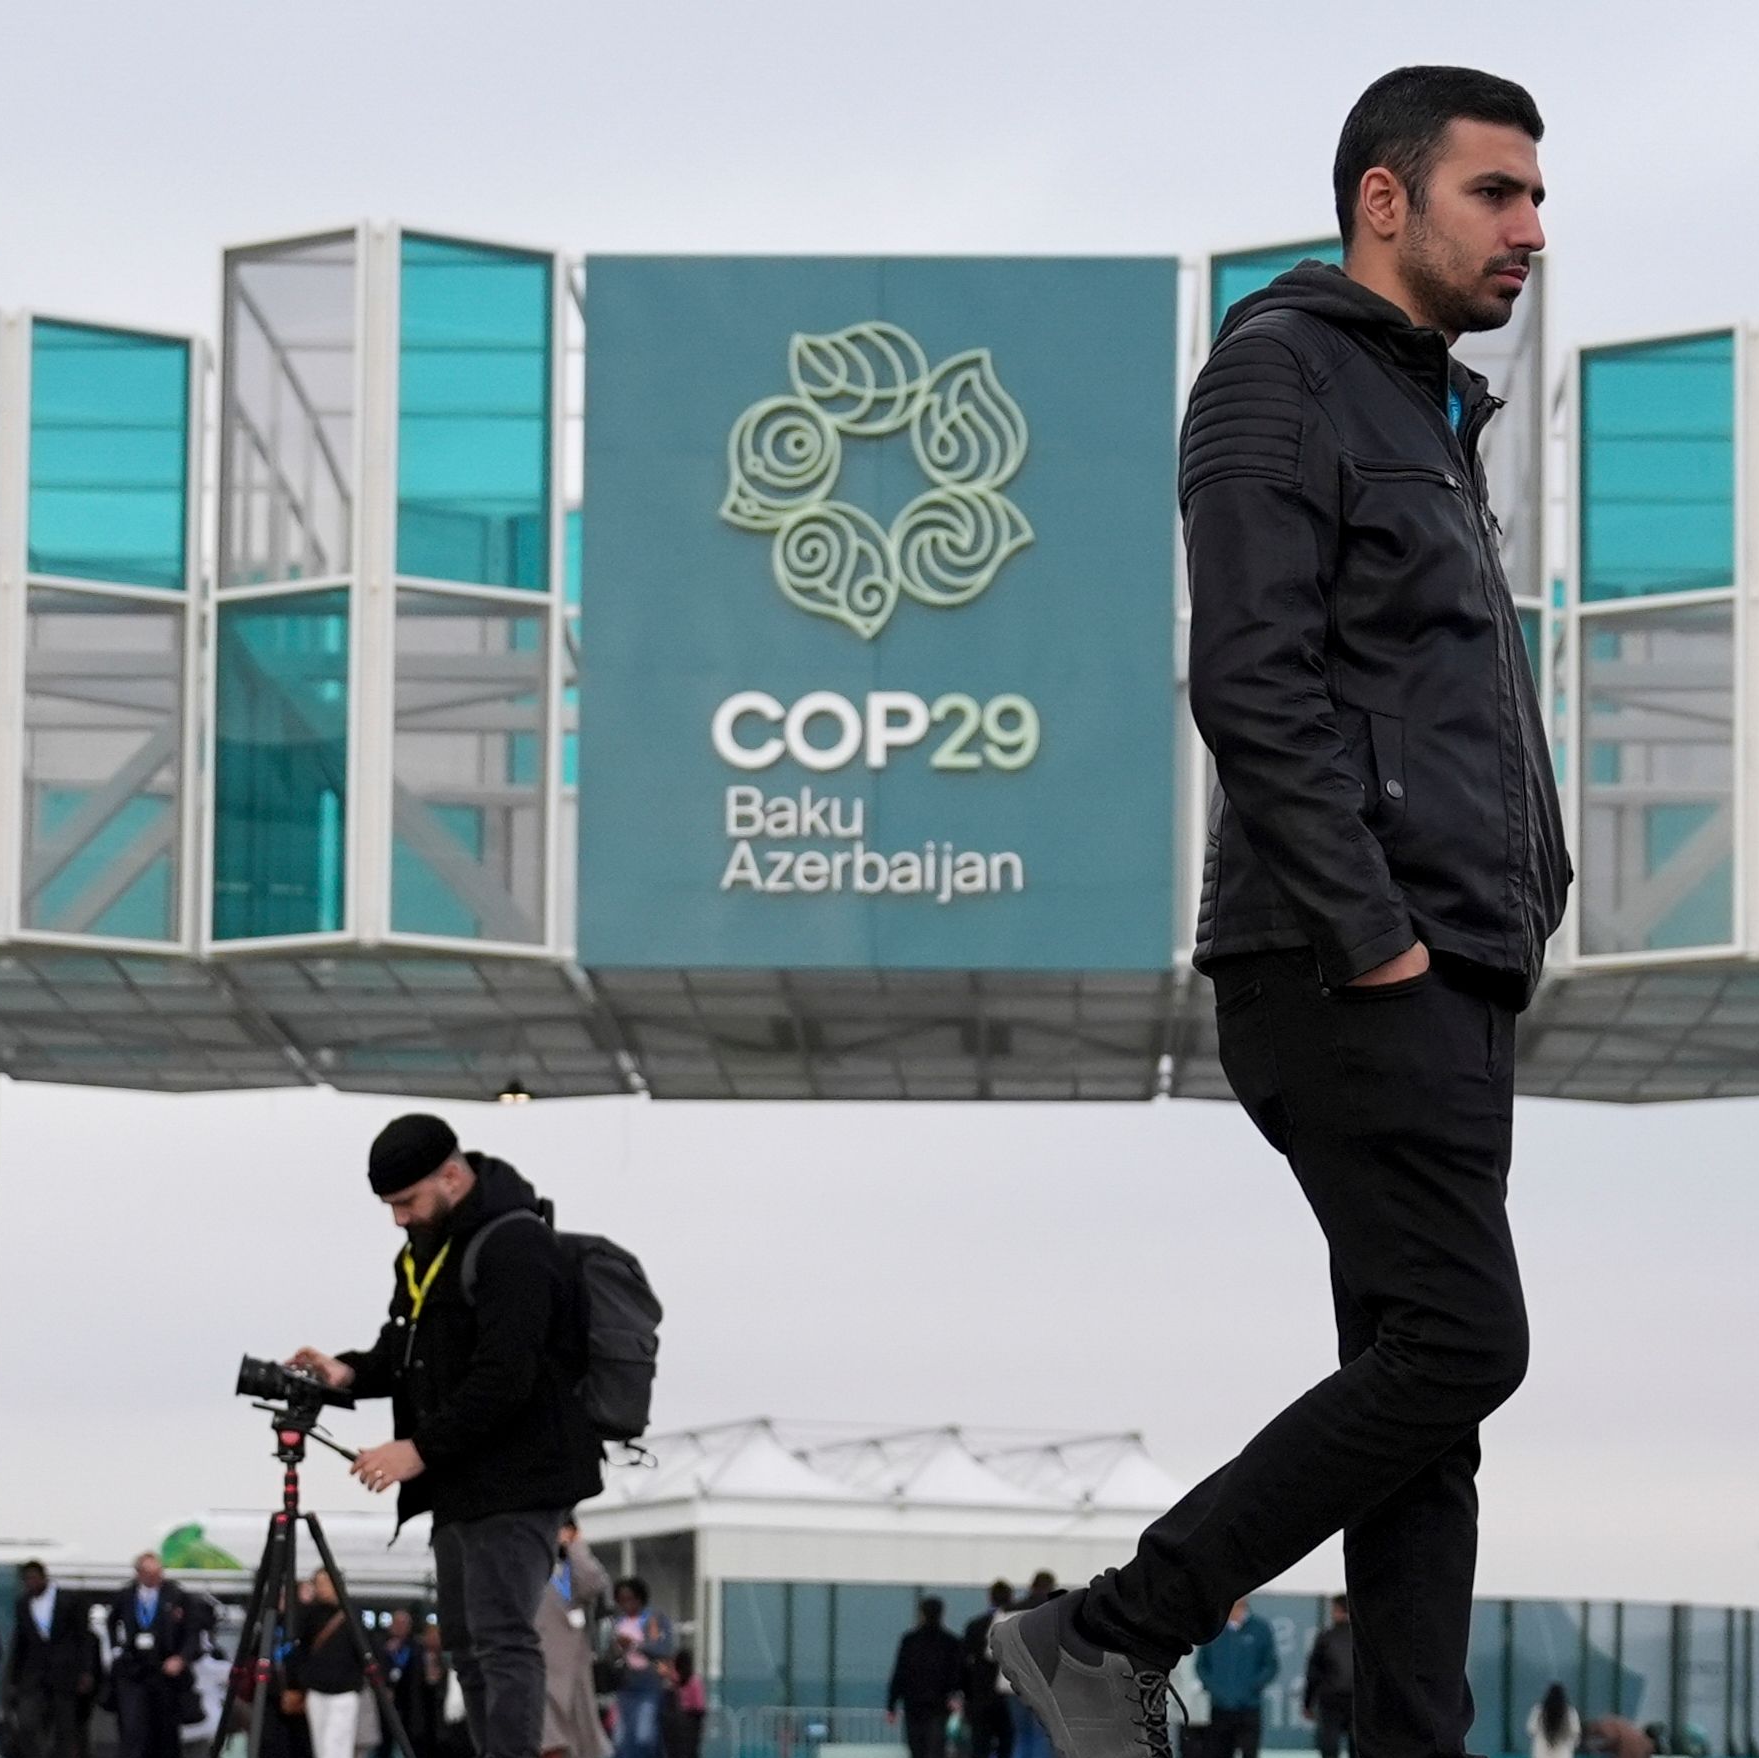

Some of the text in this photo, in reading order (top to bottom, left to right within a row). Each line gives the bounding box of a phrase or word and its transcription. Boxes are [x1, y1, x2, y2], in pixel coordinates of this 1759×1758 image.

[710, 689, 1040, 771] COP29
[724, 785, 864, 838] Baku
[720, 840, 1024, 903] Azerbaijan
